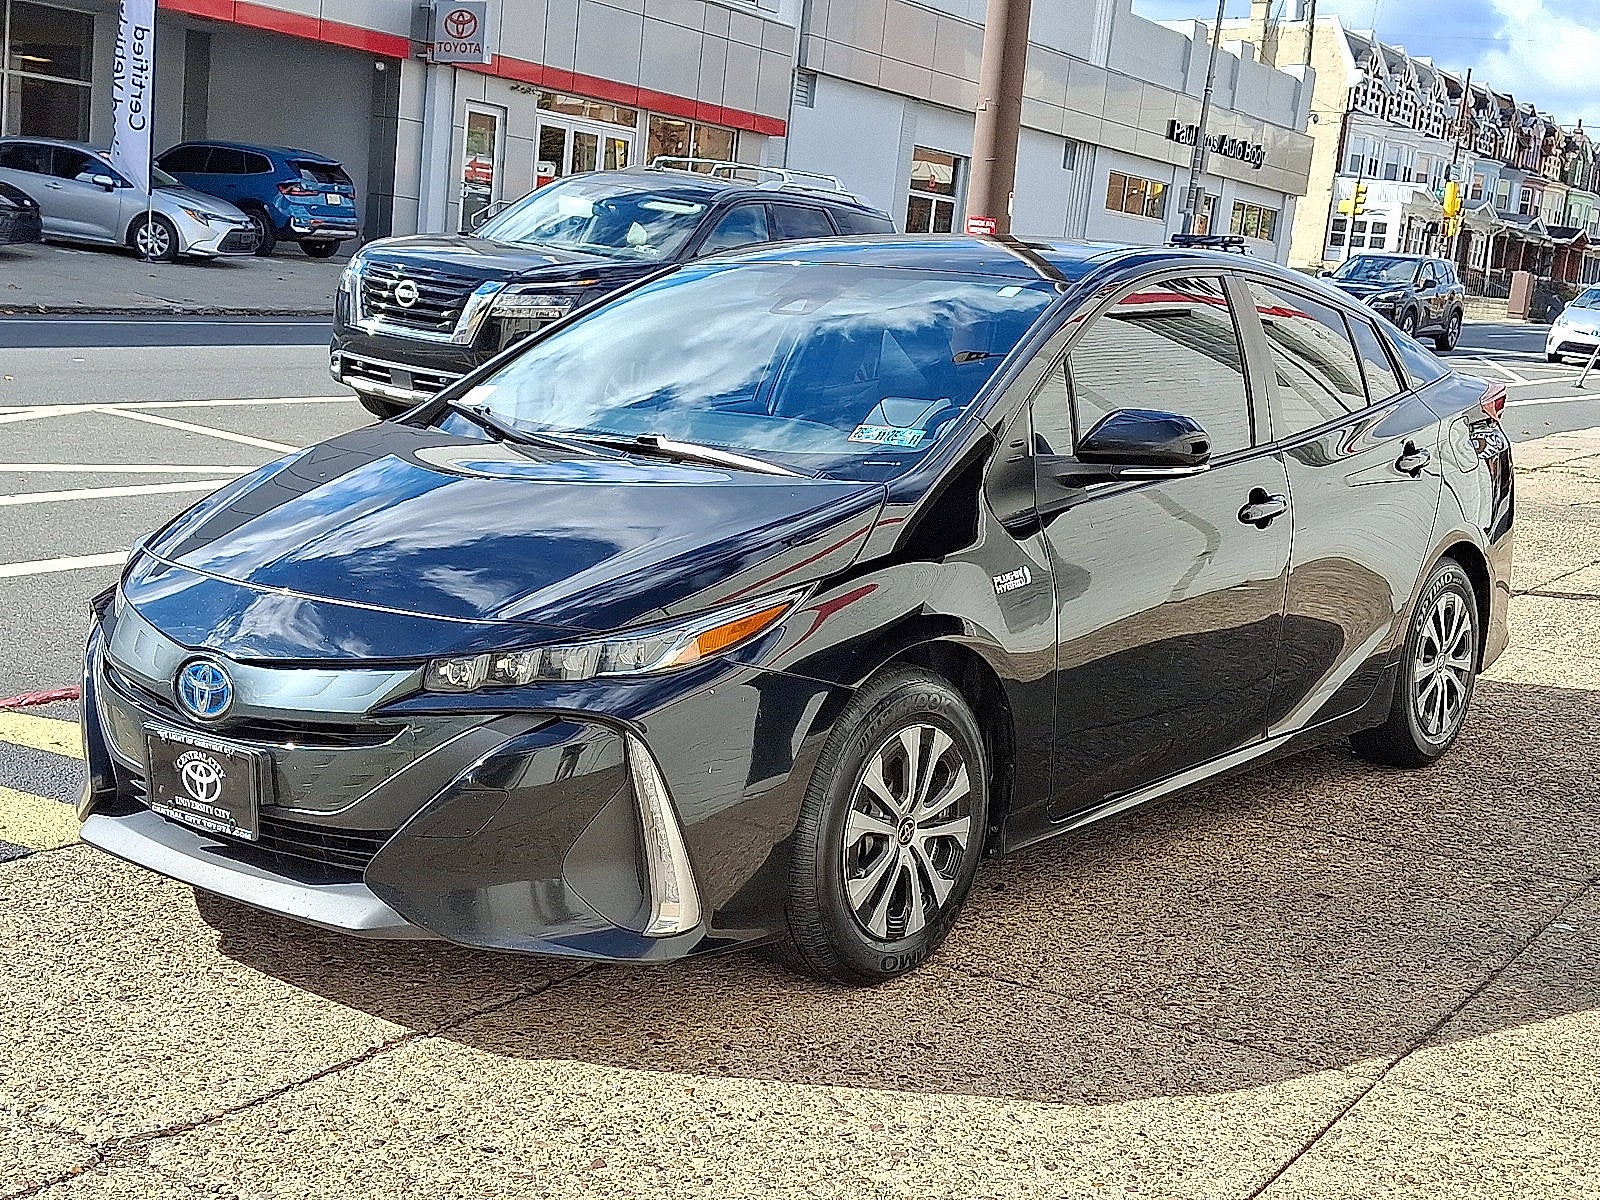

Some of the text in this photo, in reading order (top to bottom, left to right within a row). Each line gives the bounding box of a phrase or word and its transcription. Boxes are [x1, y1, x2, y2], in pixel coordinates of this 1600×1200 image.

[438, 41, 481, 54] TOYOTA
[1168, 119, 1199, 147] Paul
[176, 750, 227, 779] CENTRAL CITY
[174, 795, 231, 820] UNIVERSITY CITY
